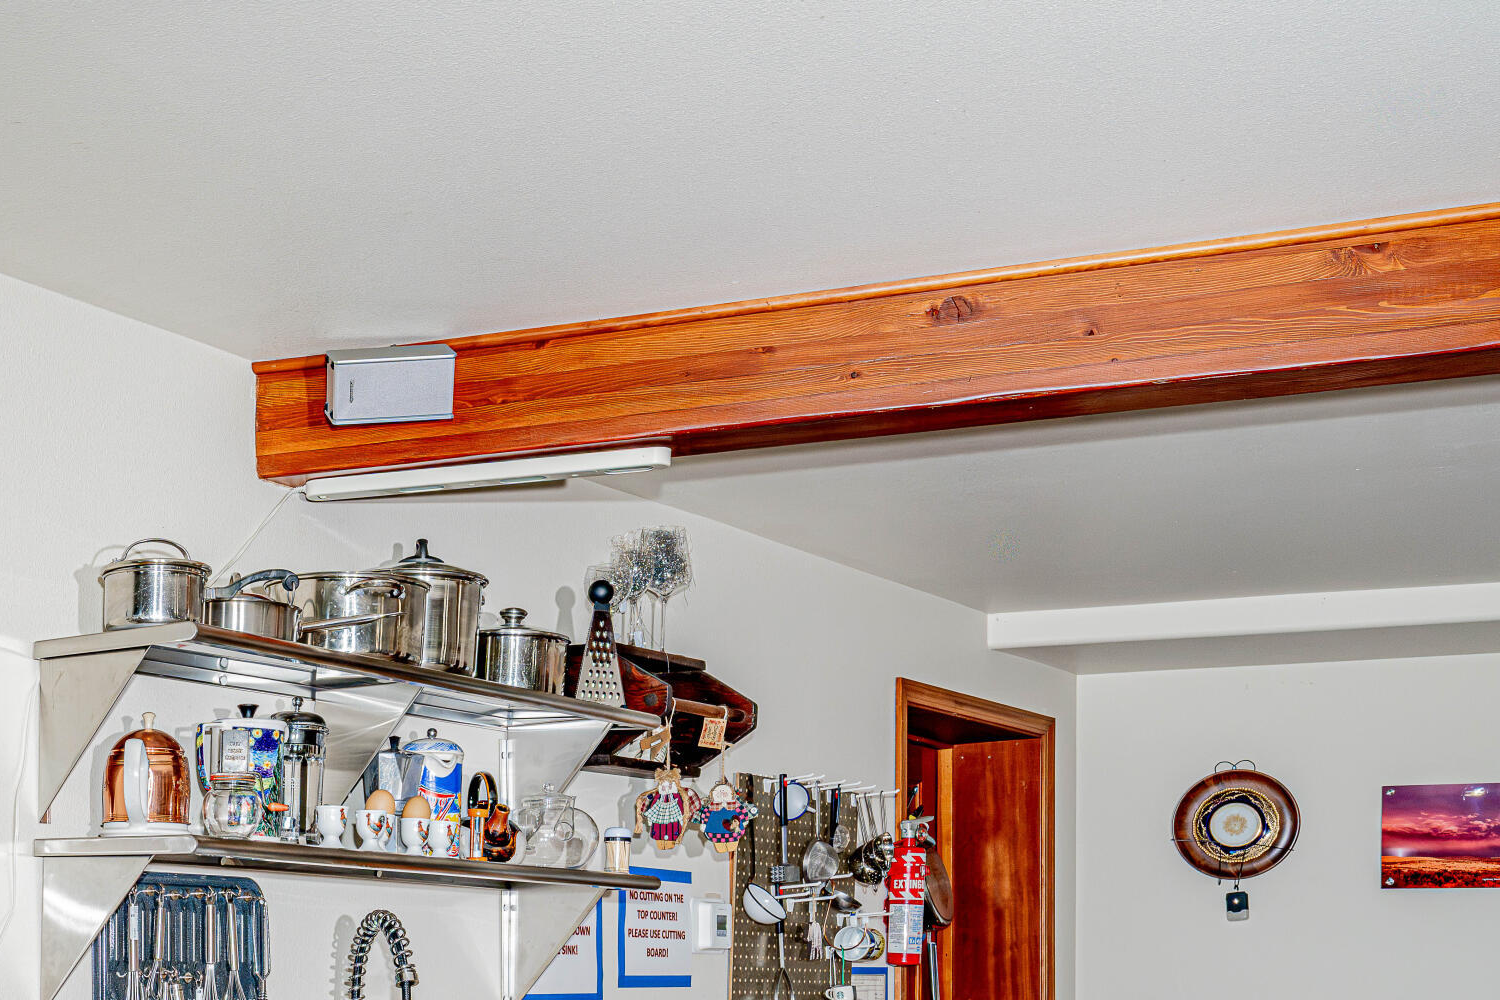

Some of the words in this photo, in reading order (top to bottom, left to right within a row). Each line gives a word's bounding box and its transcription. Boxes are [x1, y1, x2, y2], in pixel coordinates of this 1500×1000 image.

[893, 879, 925, 889] EXTING
[629, 889, 638, 900] NO
[639, 891, 664, 902] CUTTING
[664, 893, 673, 903] ON
[673, 893, 684, 904] THE
[637, 909, 649, 920] TOP
[649, 910, 678, 921] COUNTER!
[572, 925, 591, 937] OWN
[627, 928, 649, 939] PLEASE
[649, 929, 661, 939] USE
[661, 929, 686, 940] CUTTING
[561, 944, 579, 955] SINK!
[646, 947, 669, 958] BOARD!
